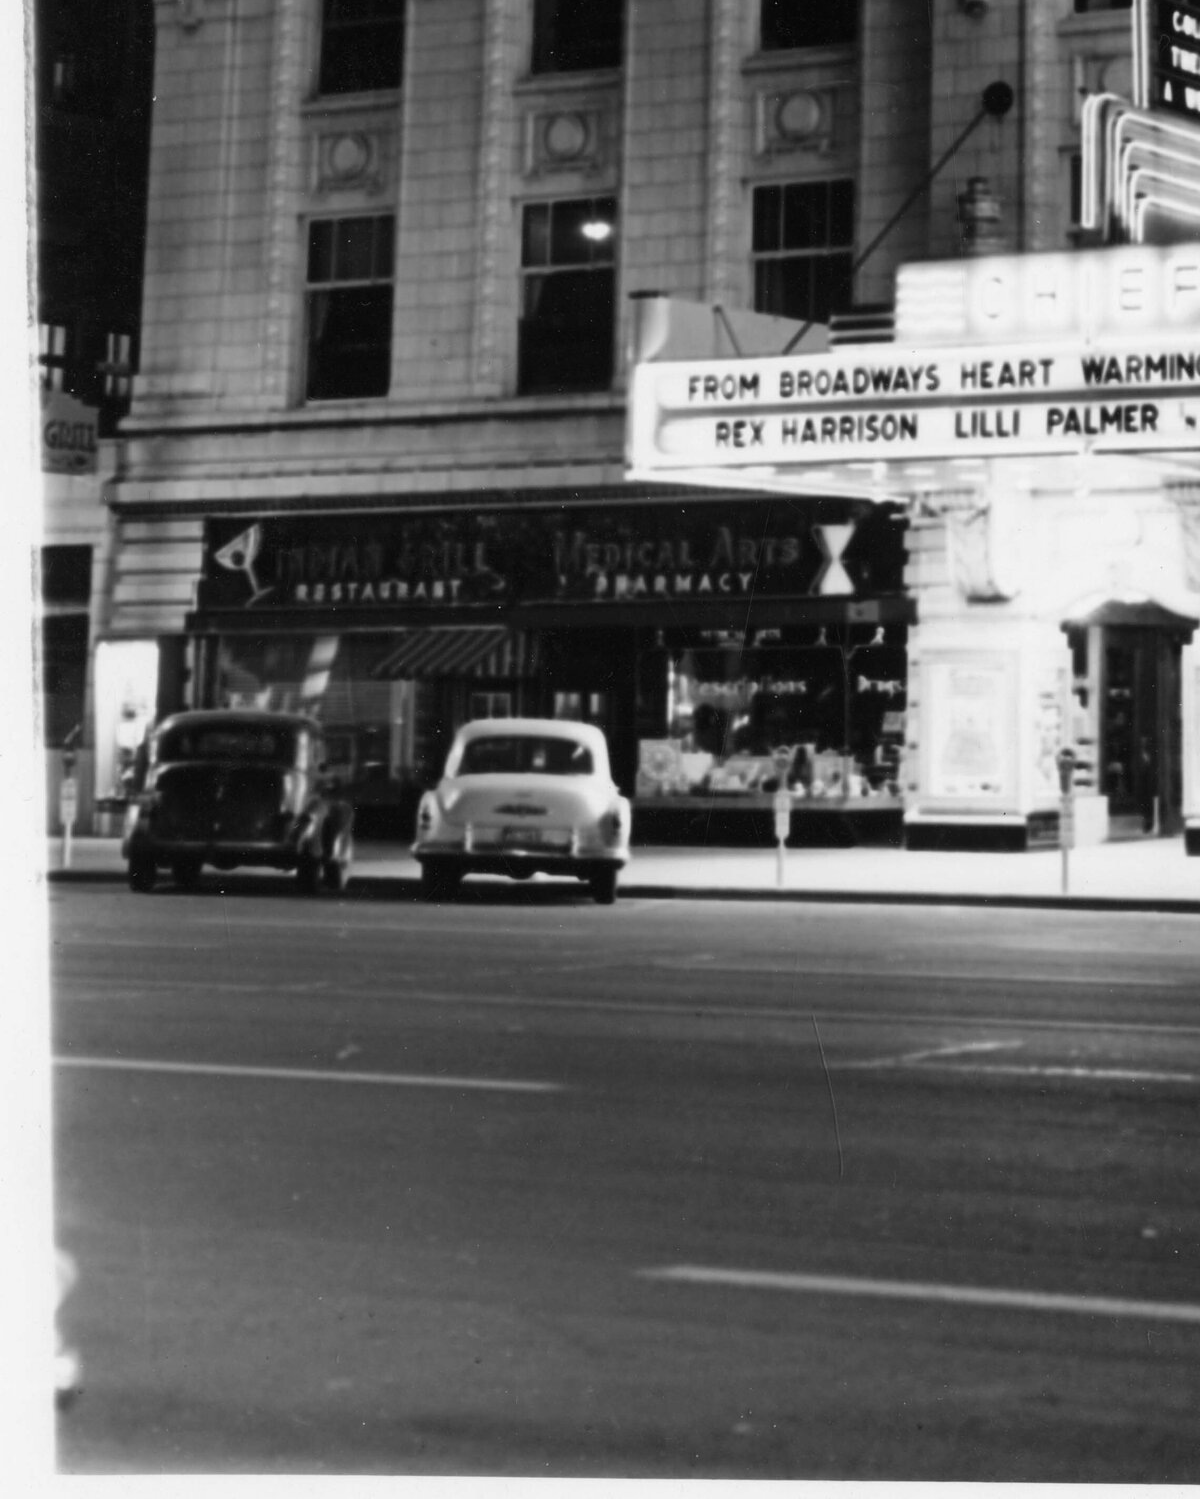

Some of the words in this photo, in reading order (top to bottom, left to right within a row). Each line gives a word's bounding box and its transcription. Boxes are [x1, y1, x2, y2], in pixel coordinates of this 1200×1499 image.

[688, 373, 760, 400] FROM
[779, 363, 941, 397] BROADWAYS
[961, 358, 1055, 389] HEART
[715, 419, 766, 449] REX
[781, 413, 918, 445] HARRISON
[955, 408, 1021, 438] LILLI
[1046, 404, 1159, 435] PALMER
[710, 527, 800, 567] ARTS
[295, 579, 461, 602] RESTAURANT
[595, 572, 753, 594] PHARMACY
